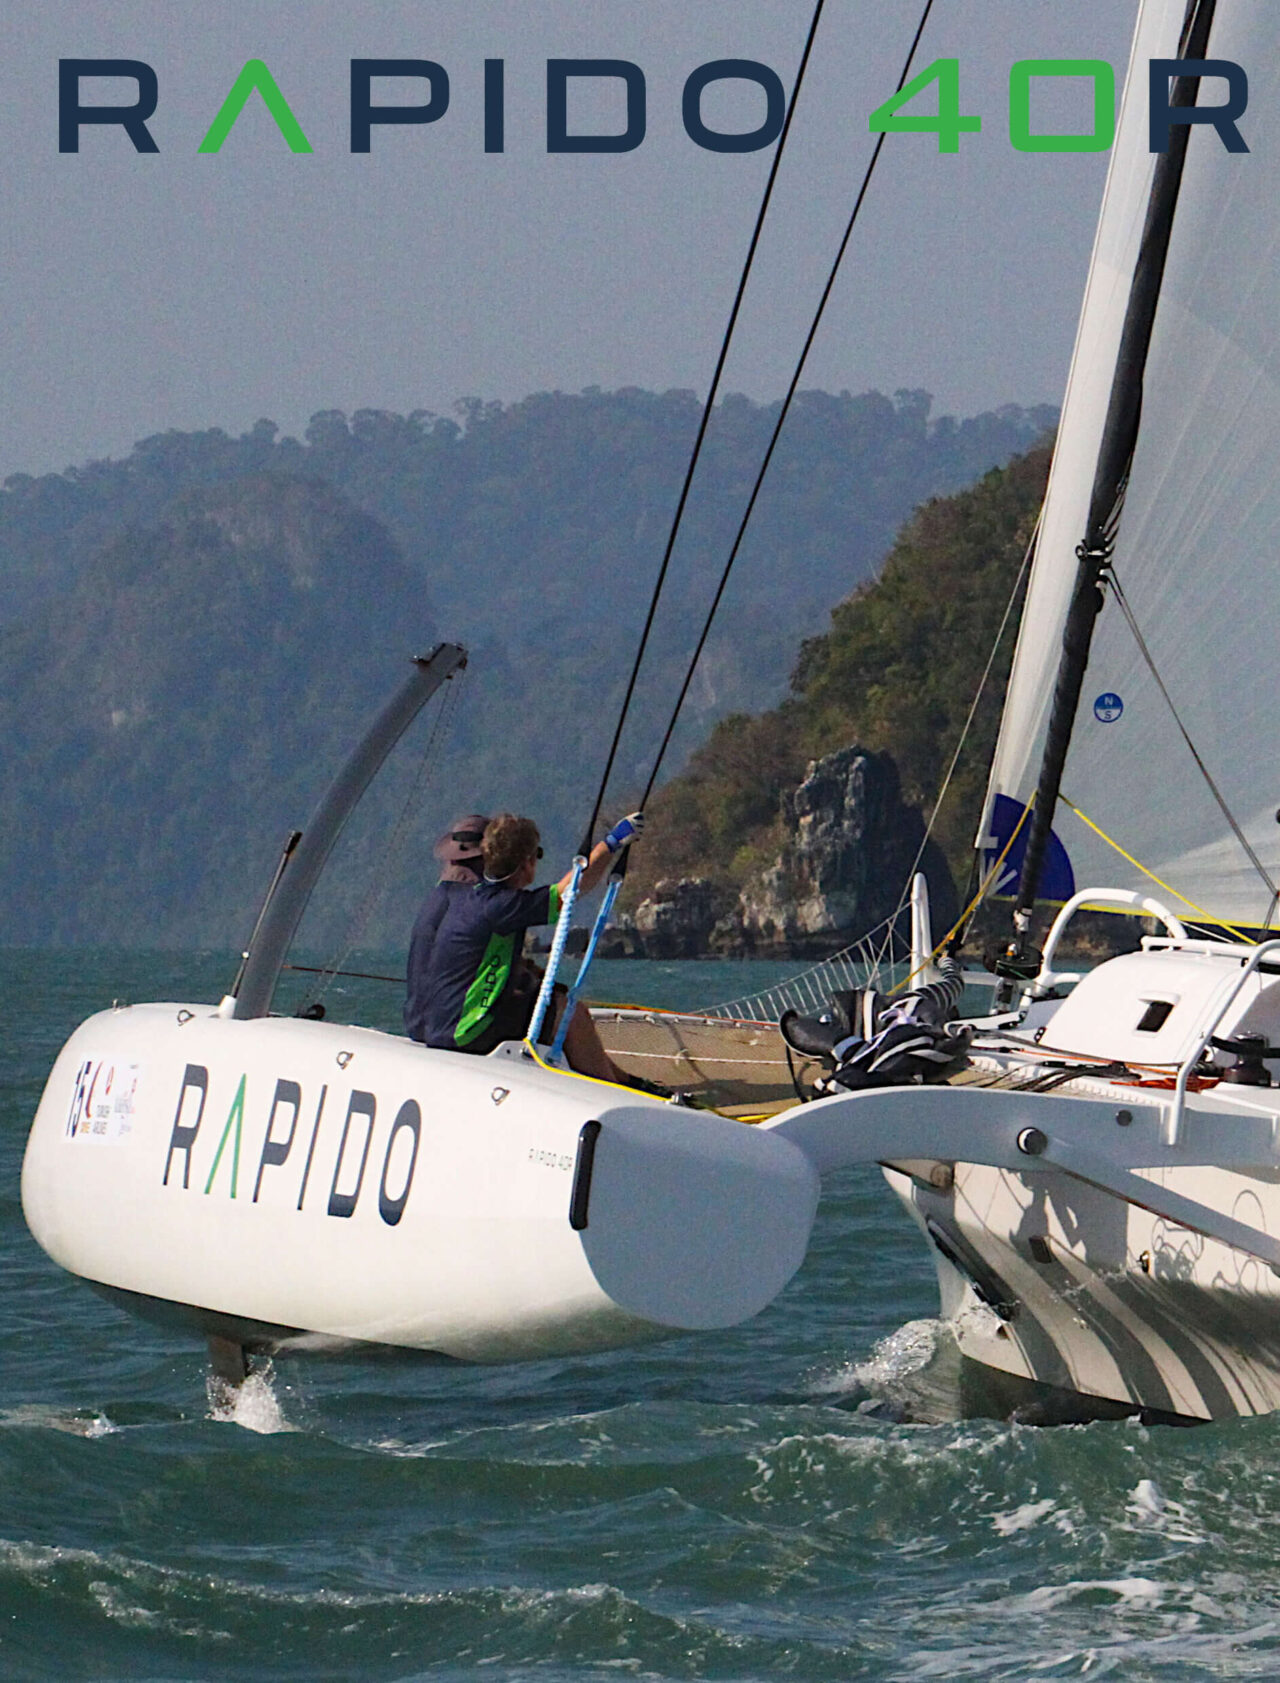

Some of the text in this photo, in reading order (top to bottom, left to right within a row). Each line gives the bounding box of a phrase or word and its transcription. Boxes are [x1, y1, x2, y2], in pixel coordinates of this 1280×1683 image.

[1104, 696, 1114, 706] N
[1104, 710, 1112, 720] S
[480, 955, 501, 1009] PIDO
[162, 1063, 423, 1227] RAPIDO
